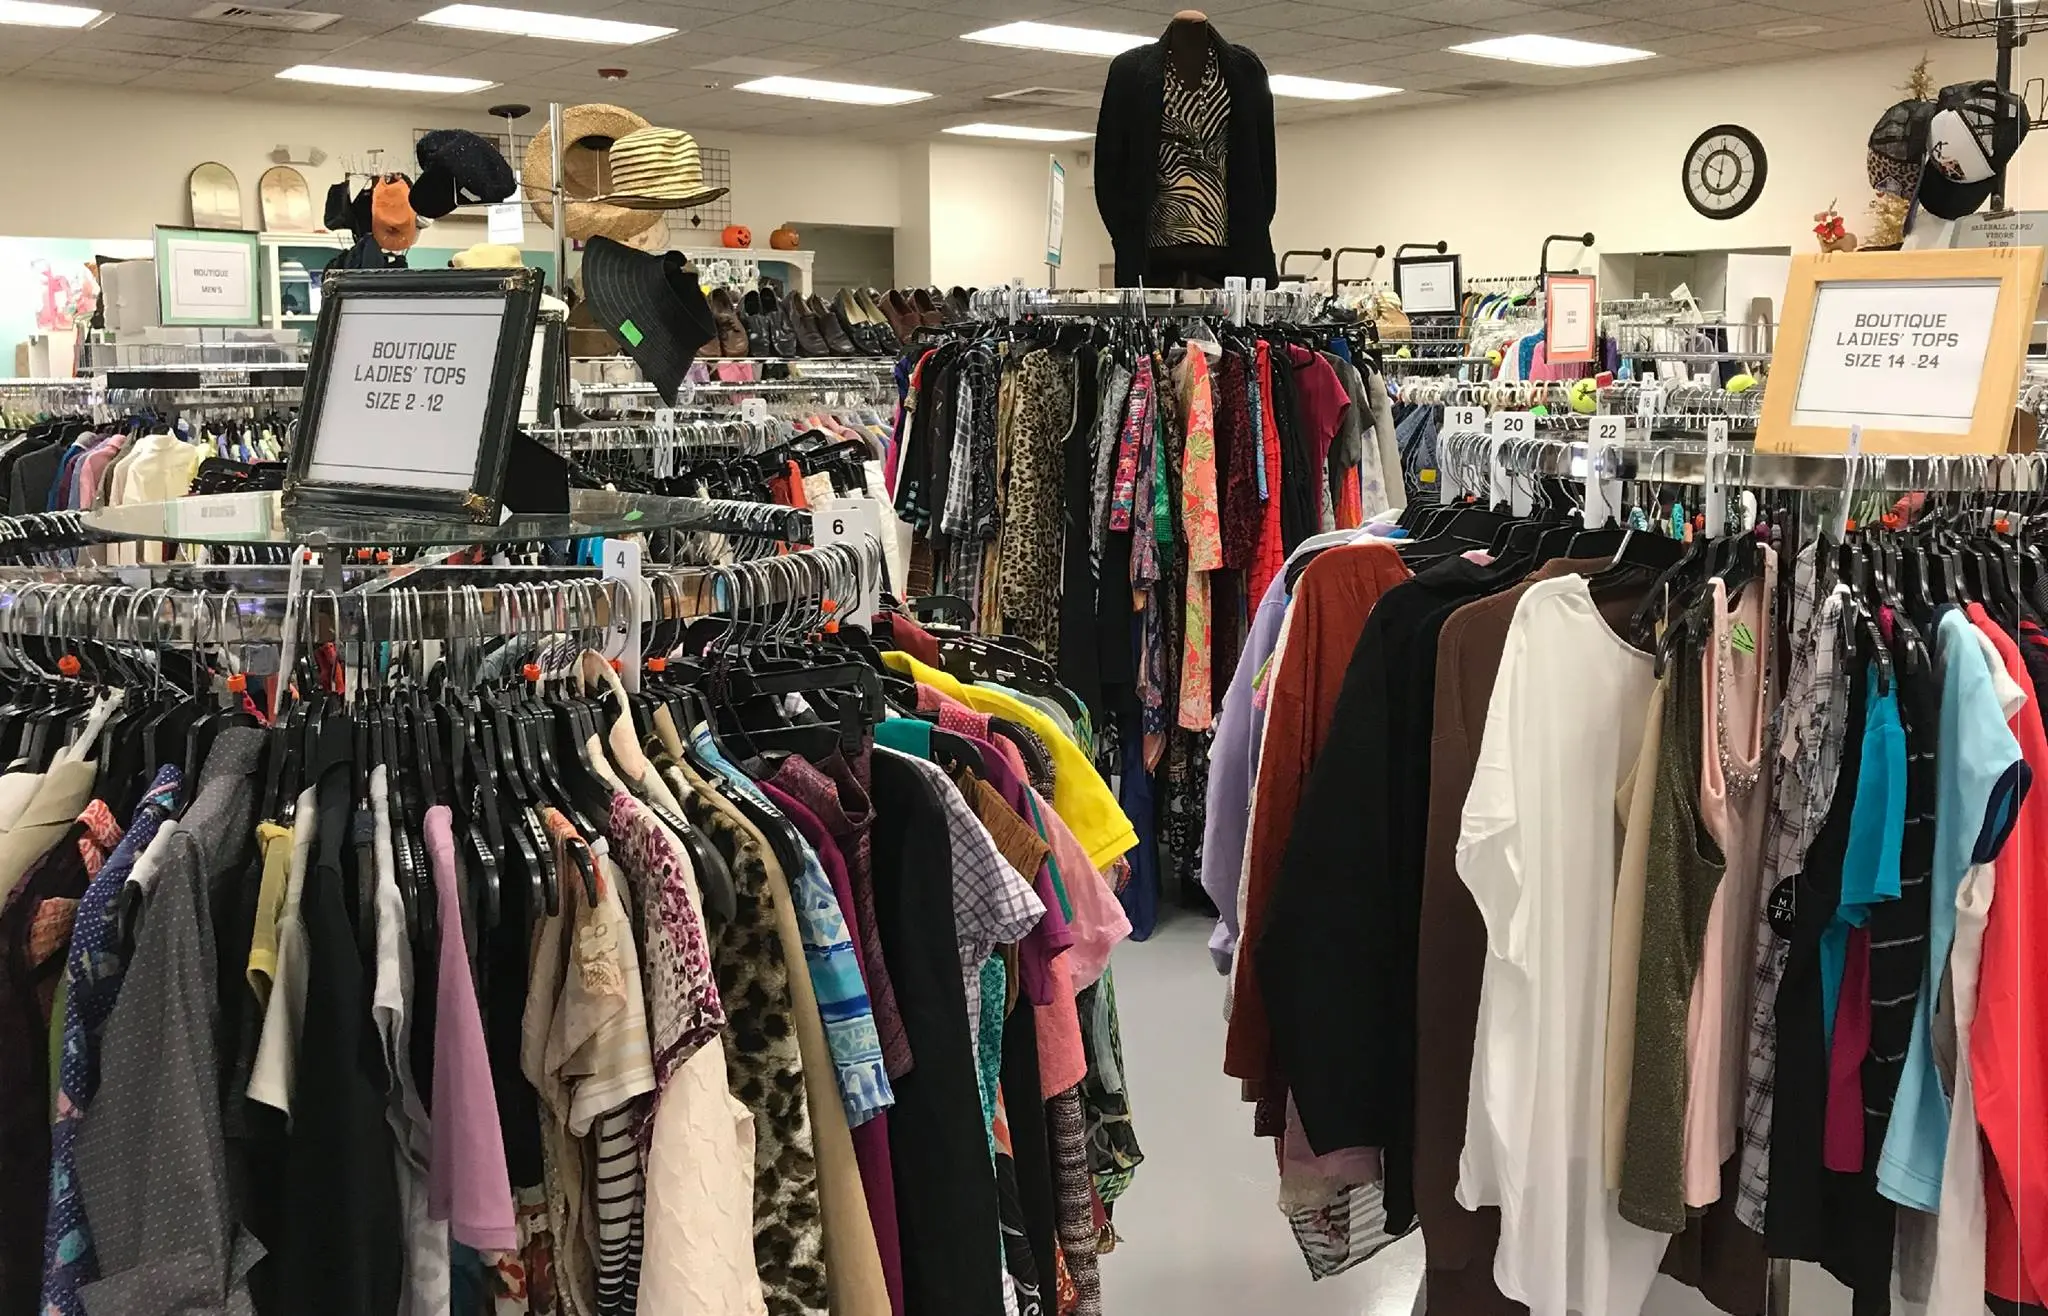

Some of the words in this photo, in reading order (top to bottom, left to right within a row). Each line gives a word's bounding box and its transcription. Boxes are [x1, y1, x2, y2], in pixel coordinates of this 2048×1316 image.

[1855, 314, 1947, 328] BOUTIQUE
[1836, 332, 1904, 346] LADIES'
[1912, 333, 1959, 347] TOPS
[372, 341, 457, 360] BOUTIQUE
[1844, 353, 1882, 367] SIZE
[1888, 355, 1904, 368] 14
[354, 365, 417, 382] LADIES'
[423, 367, 466, 385] TOPS
[365, 391, 401, 410] SIZE
[405, 394, 415, 410] 2
[748, 408, 755, 417] 6
[1455, 412, 1473, 425] 18
[1503, 418, 1524, 432] 20
[1600, 425, 1617, 439] 22
[1714, 427, 1724, 443] 24
[832, 519, 844, 536] 6
[616, 551, 626, 569] 4
